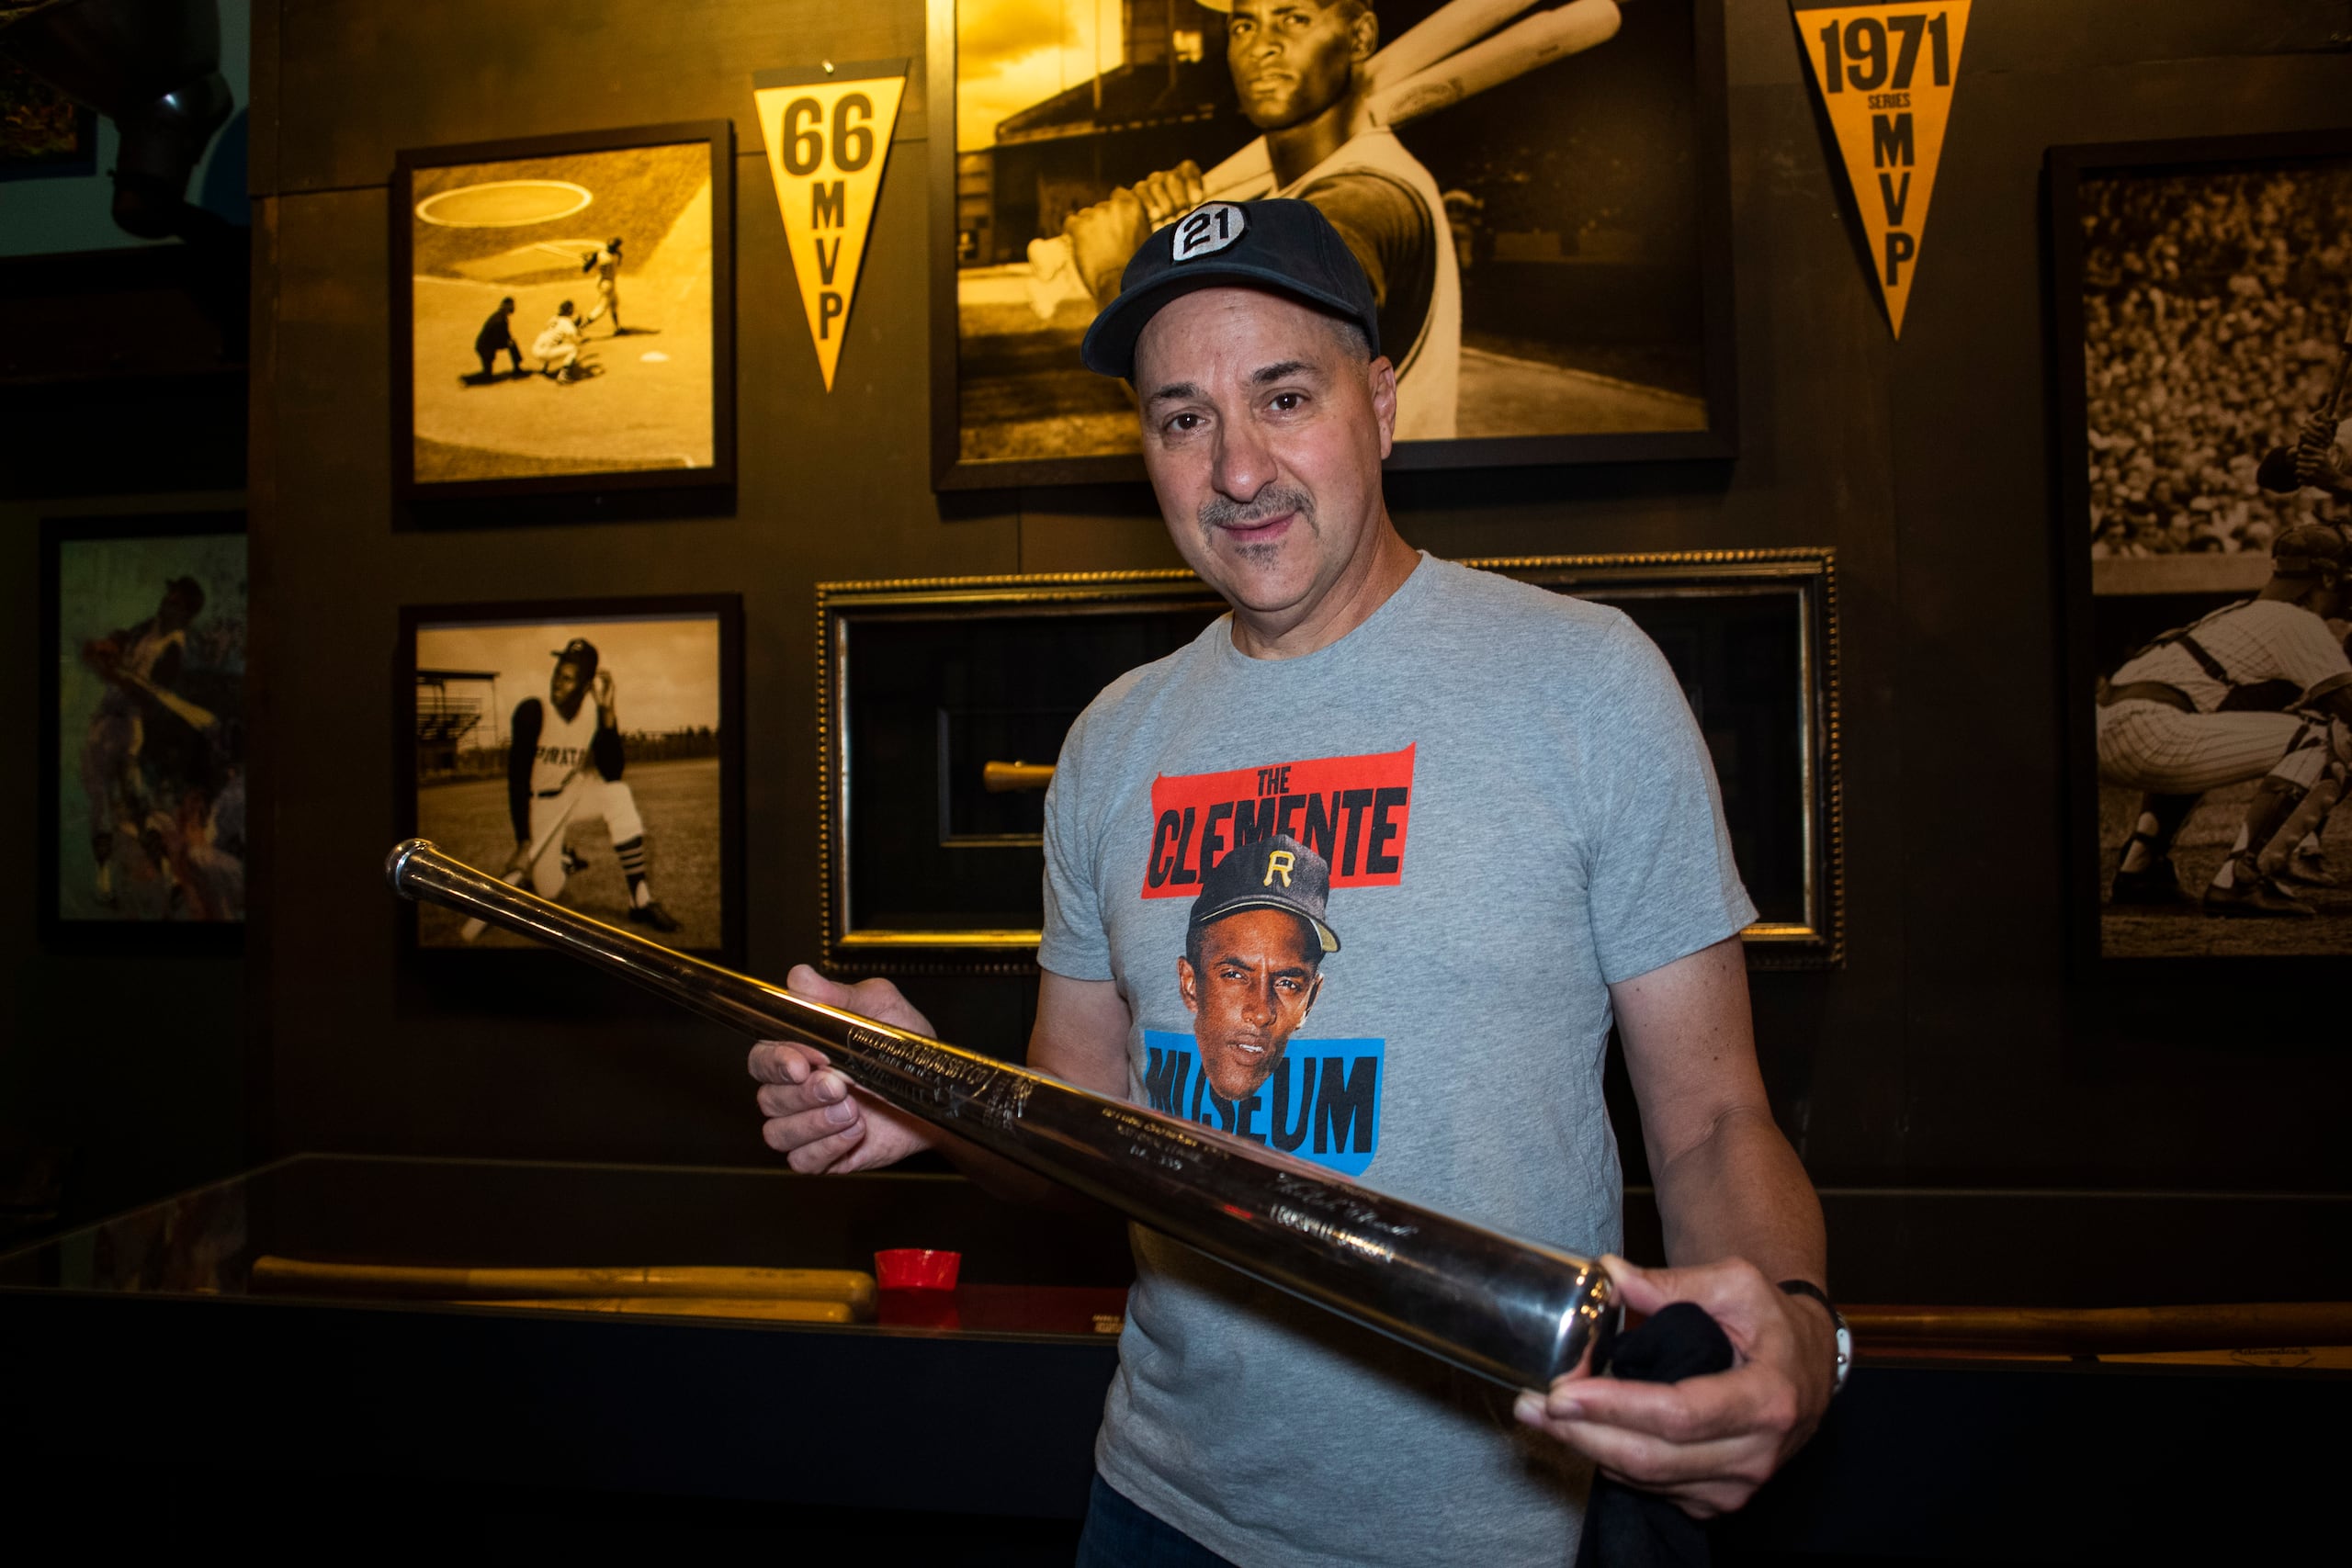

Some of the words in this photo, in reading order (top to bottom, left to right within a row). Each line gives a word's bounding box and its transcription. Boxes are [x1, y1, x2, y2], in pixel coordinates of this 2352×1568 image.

[1820, 11, 1951, 94] 1971
[1868, 93, 1911, 110] SERIES
[782, 93, 875, 177] 66
[1182, 208, 1229, 254] 21
[1257, 766, 1292, 796] THE
[1263, 851, 1296, 887] R
